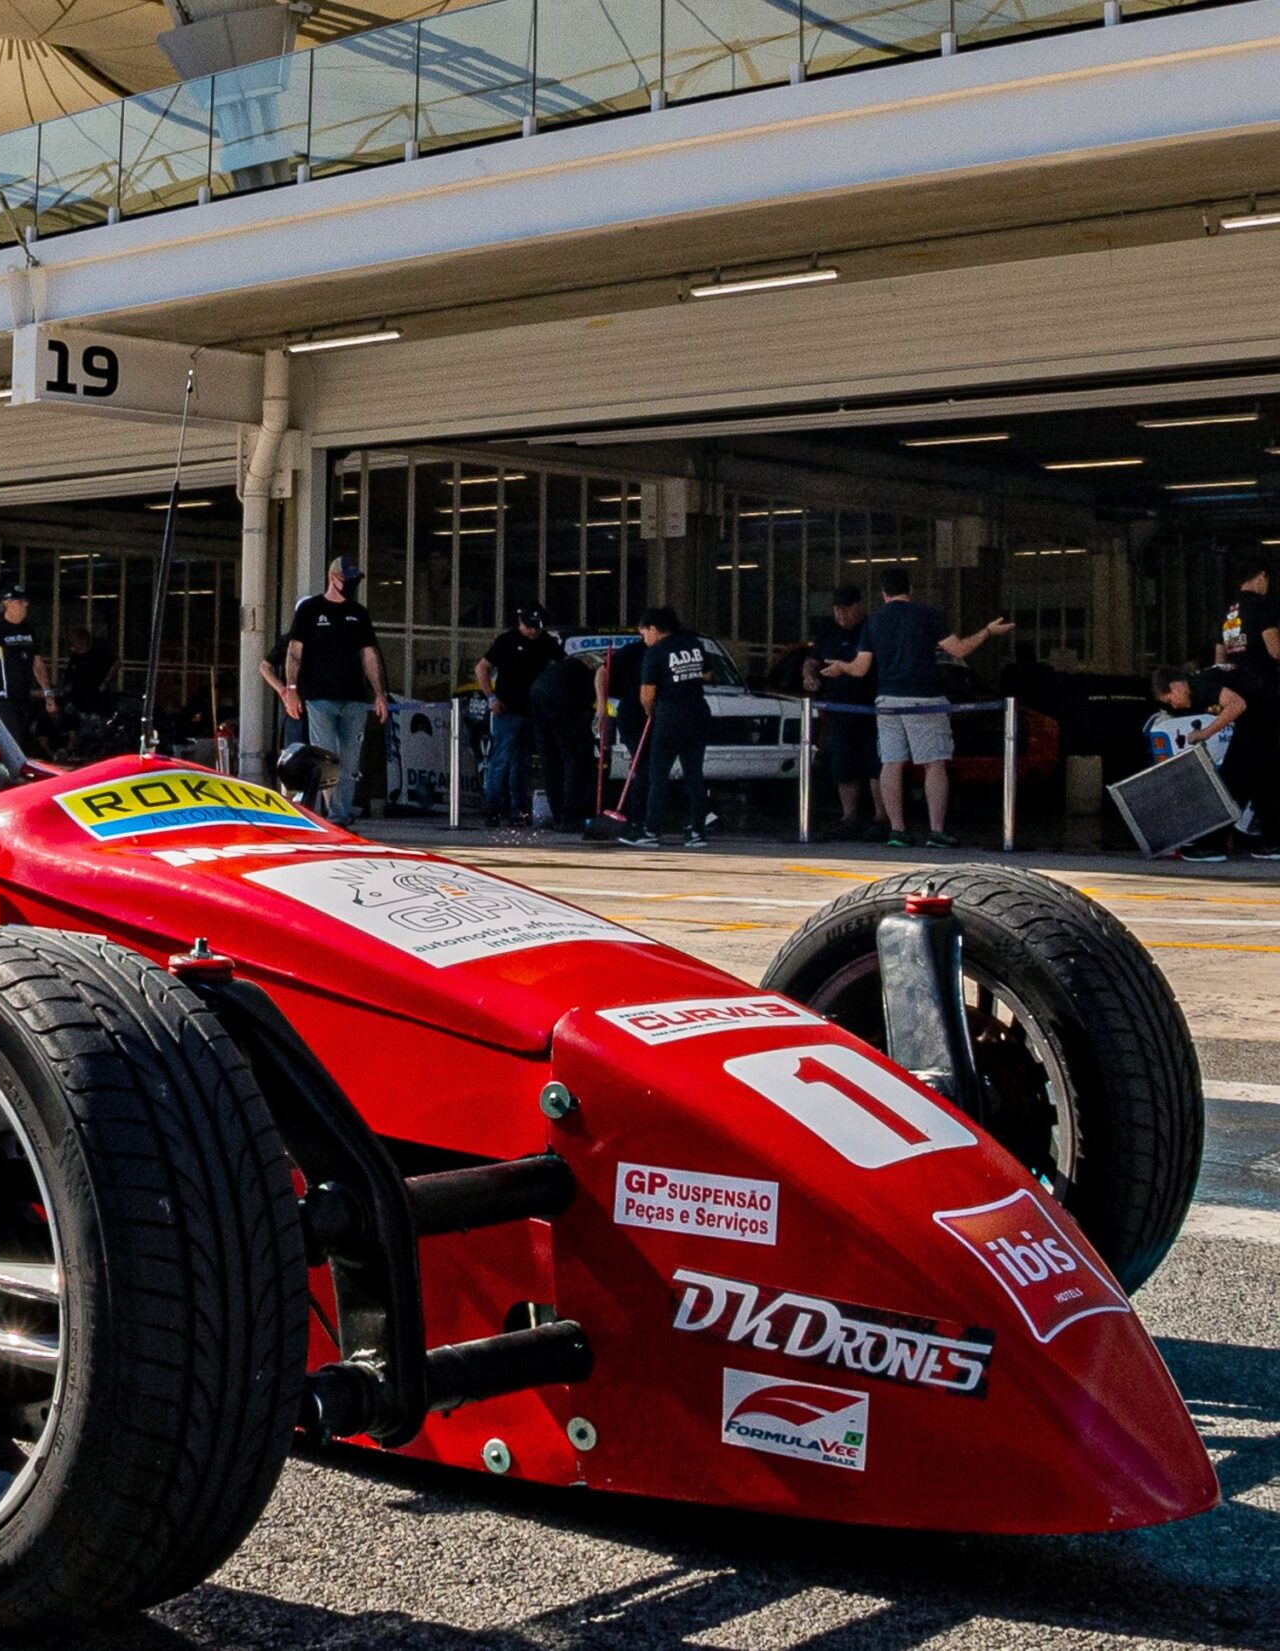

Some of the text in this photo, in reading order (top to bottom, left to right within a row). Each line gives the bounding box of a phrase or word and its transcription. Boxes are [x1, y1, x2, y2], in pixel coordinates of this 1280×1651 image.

[45, 339, 120, 398] 19
[81, 778, 288, 818] ROKIM
[150, 806, 270, 828] AUTOMOTIVE
[414, 924, 520, 953] automotive
[793, 1056, 932, 1146] 1
[624, 1169, 772, 1212] GP SUSPENSÃO
[624, 1197, 769, 1237] Peças e Serviços
[985, 1230, 1078, 1288] ibis
[1053, 1286, 1084, 1303] HOTELS
